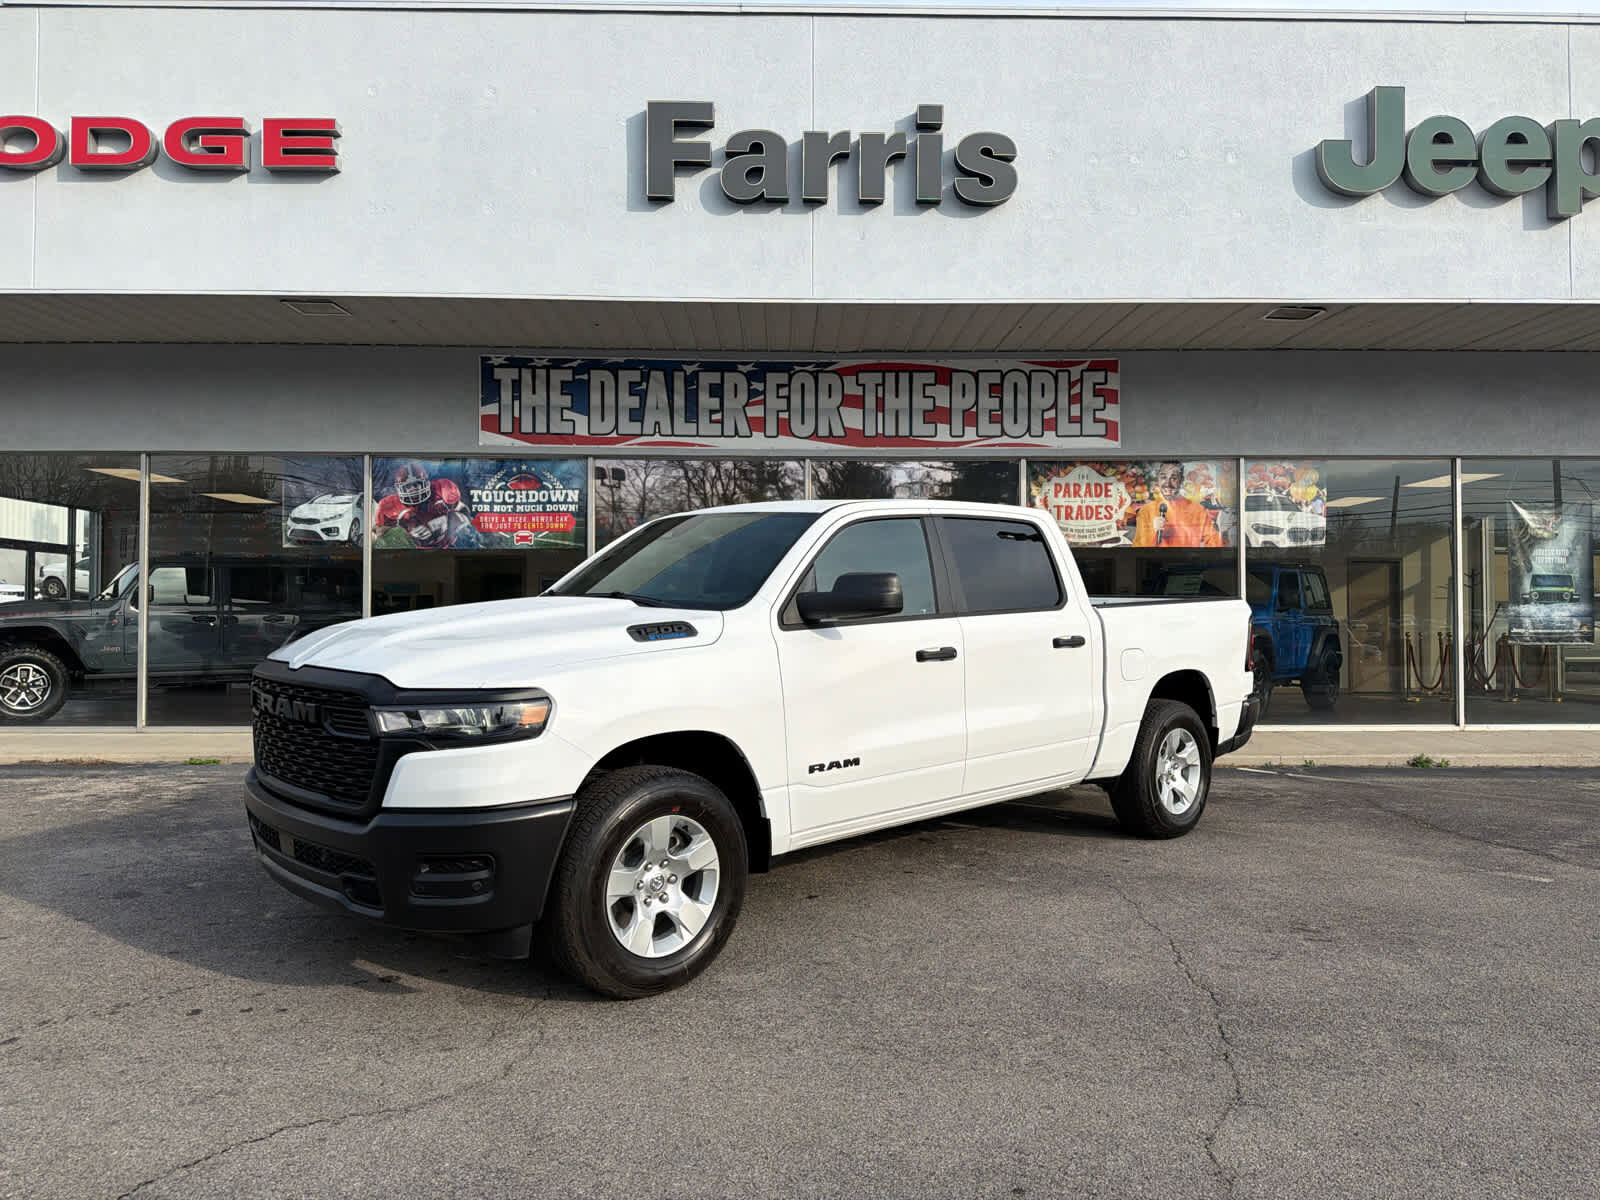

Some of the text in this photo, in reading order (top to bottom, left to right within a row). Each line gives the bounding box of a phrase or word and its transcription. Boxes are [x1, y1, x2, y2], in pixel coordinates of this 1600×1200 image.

[0, 115, 341, 175] ODGE
[645, 101, 1018, 207] Farris
[1317, 86, 1600, 219] Jeep
[493, 366, 1108, 439] THE DEALER FOR THE PEOPLE
[470, 489, 580, 503] TOUCHDOWN
[1053, 482, 1113, 498] PARADE
[472, 504, 579, 512] FOR NOT MUCH DOWN!
[1053, 504, 1114, 521] TRADES
[260, 693, 318, 722] RAM
[808, 757, 861, 774] RAM
